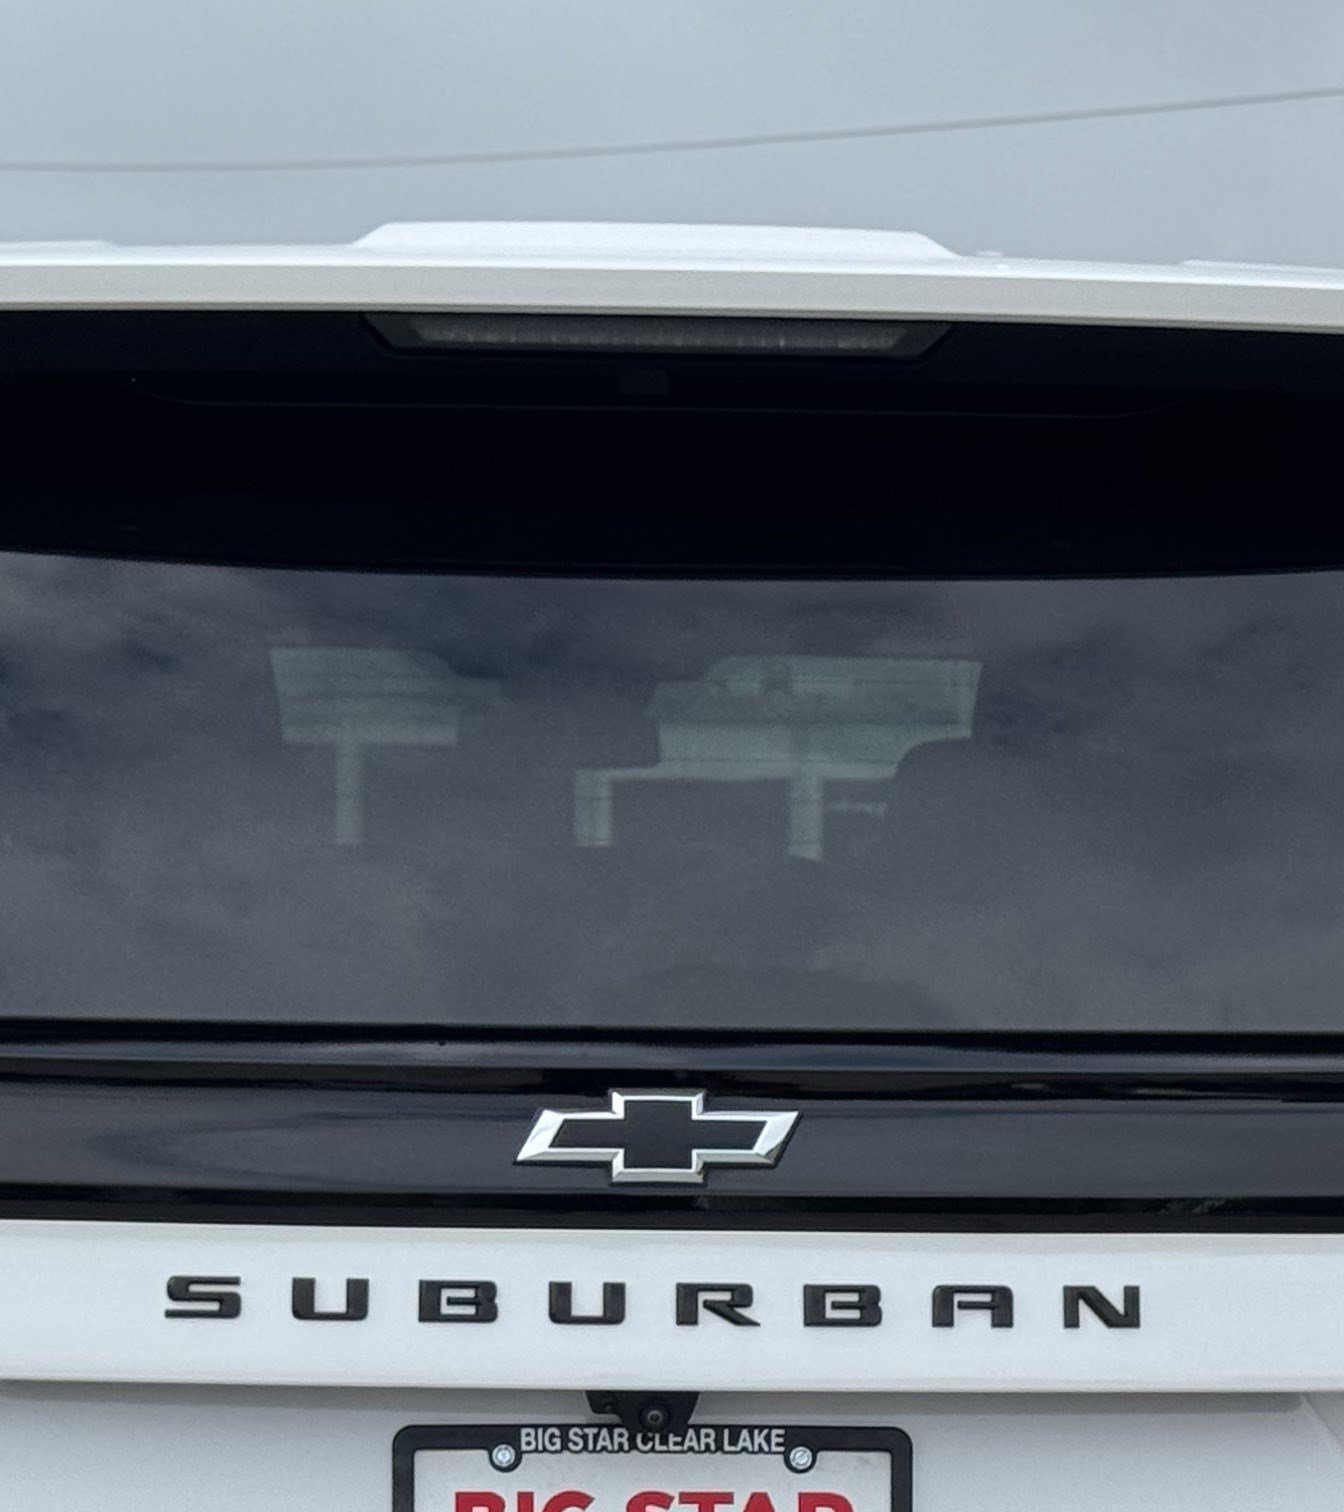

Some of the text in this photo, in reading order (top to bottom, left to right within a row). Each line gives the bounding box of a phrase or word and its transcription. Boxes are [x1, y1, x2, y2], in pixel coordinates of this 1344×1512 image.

[163, 1275, 1141, 1330] SUBURBAN
[520, 1427, 786, 1452] BIG STAR CLEAR LAKE
